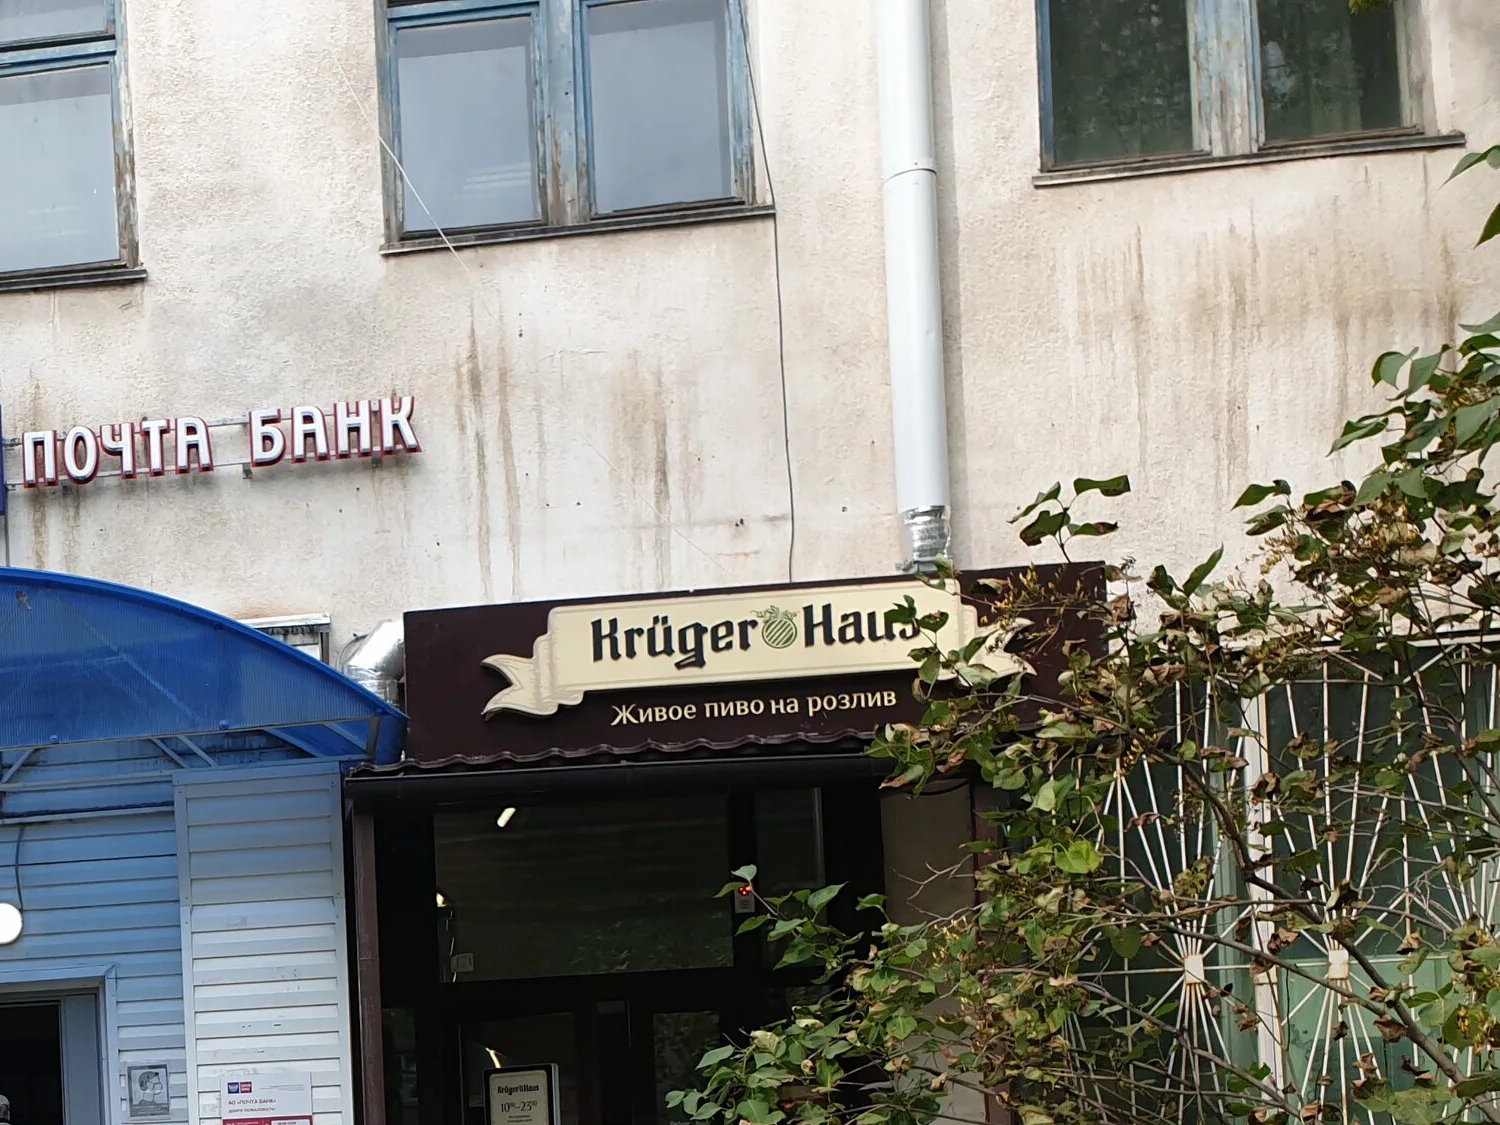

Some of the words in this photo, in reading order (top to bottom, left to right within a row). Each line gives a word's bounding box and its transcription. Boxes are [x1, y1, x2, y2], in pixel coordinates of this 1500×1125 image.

[22, 416, 214, 488] ПОЧТА
[248, 395, 421, 467] БАНК
[590, 615, 759, 671] Krüger
[610, 703, 697, 726] Живое
[704, 696, 764, 719] пиво
[769, 696, 799, 715] на
[807, 690, 897, 717] розлив
